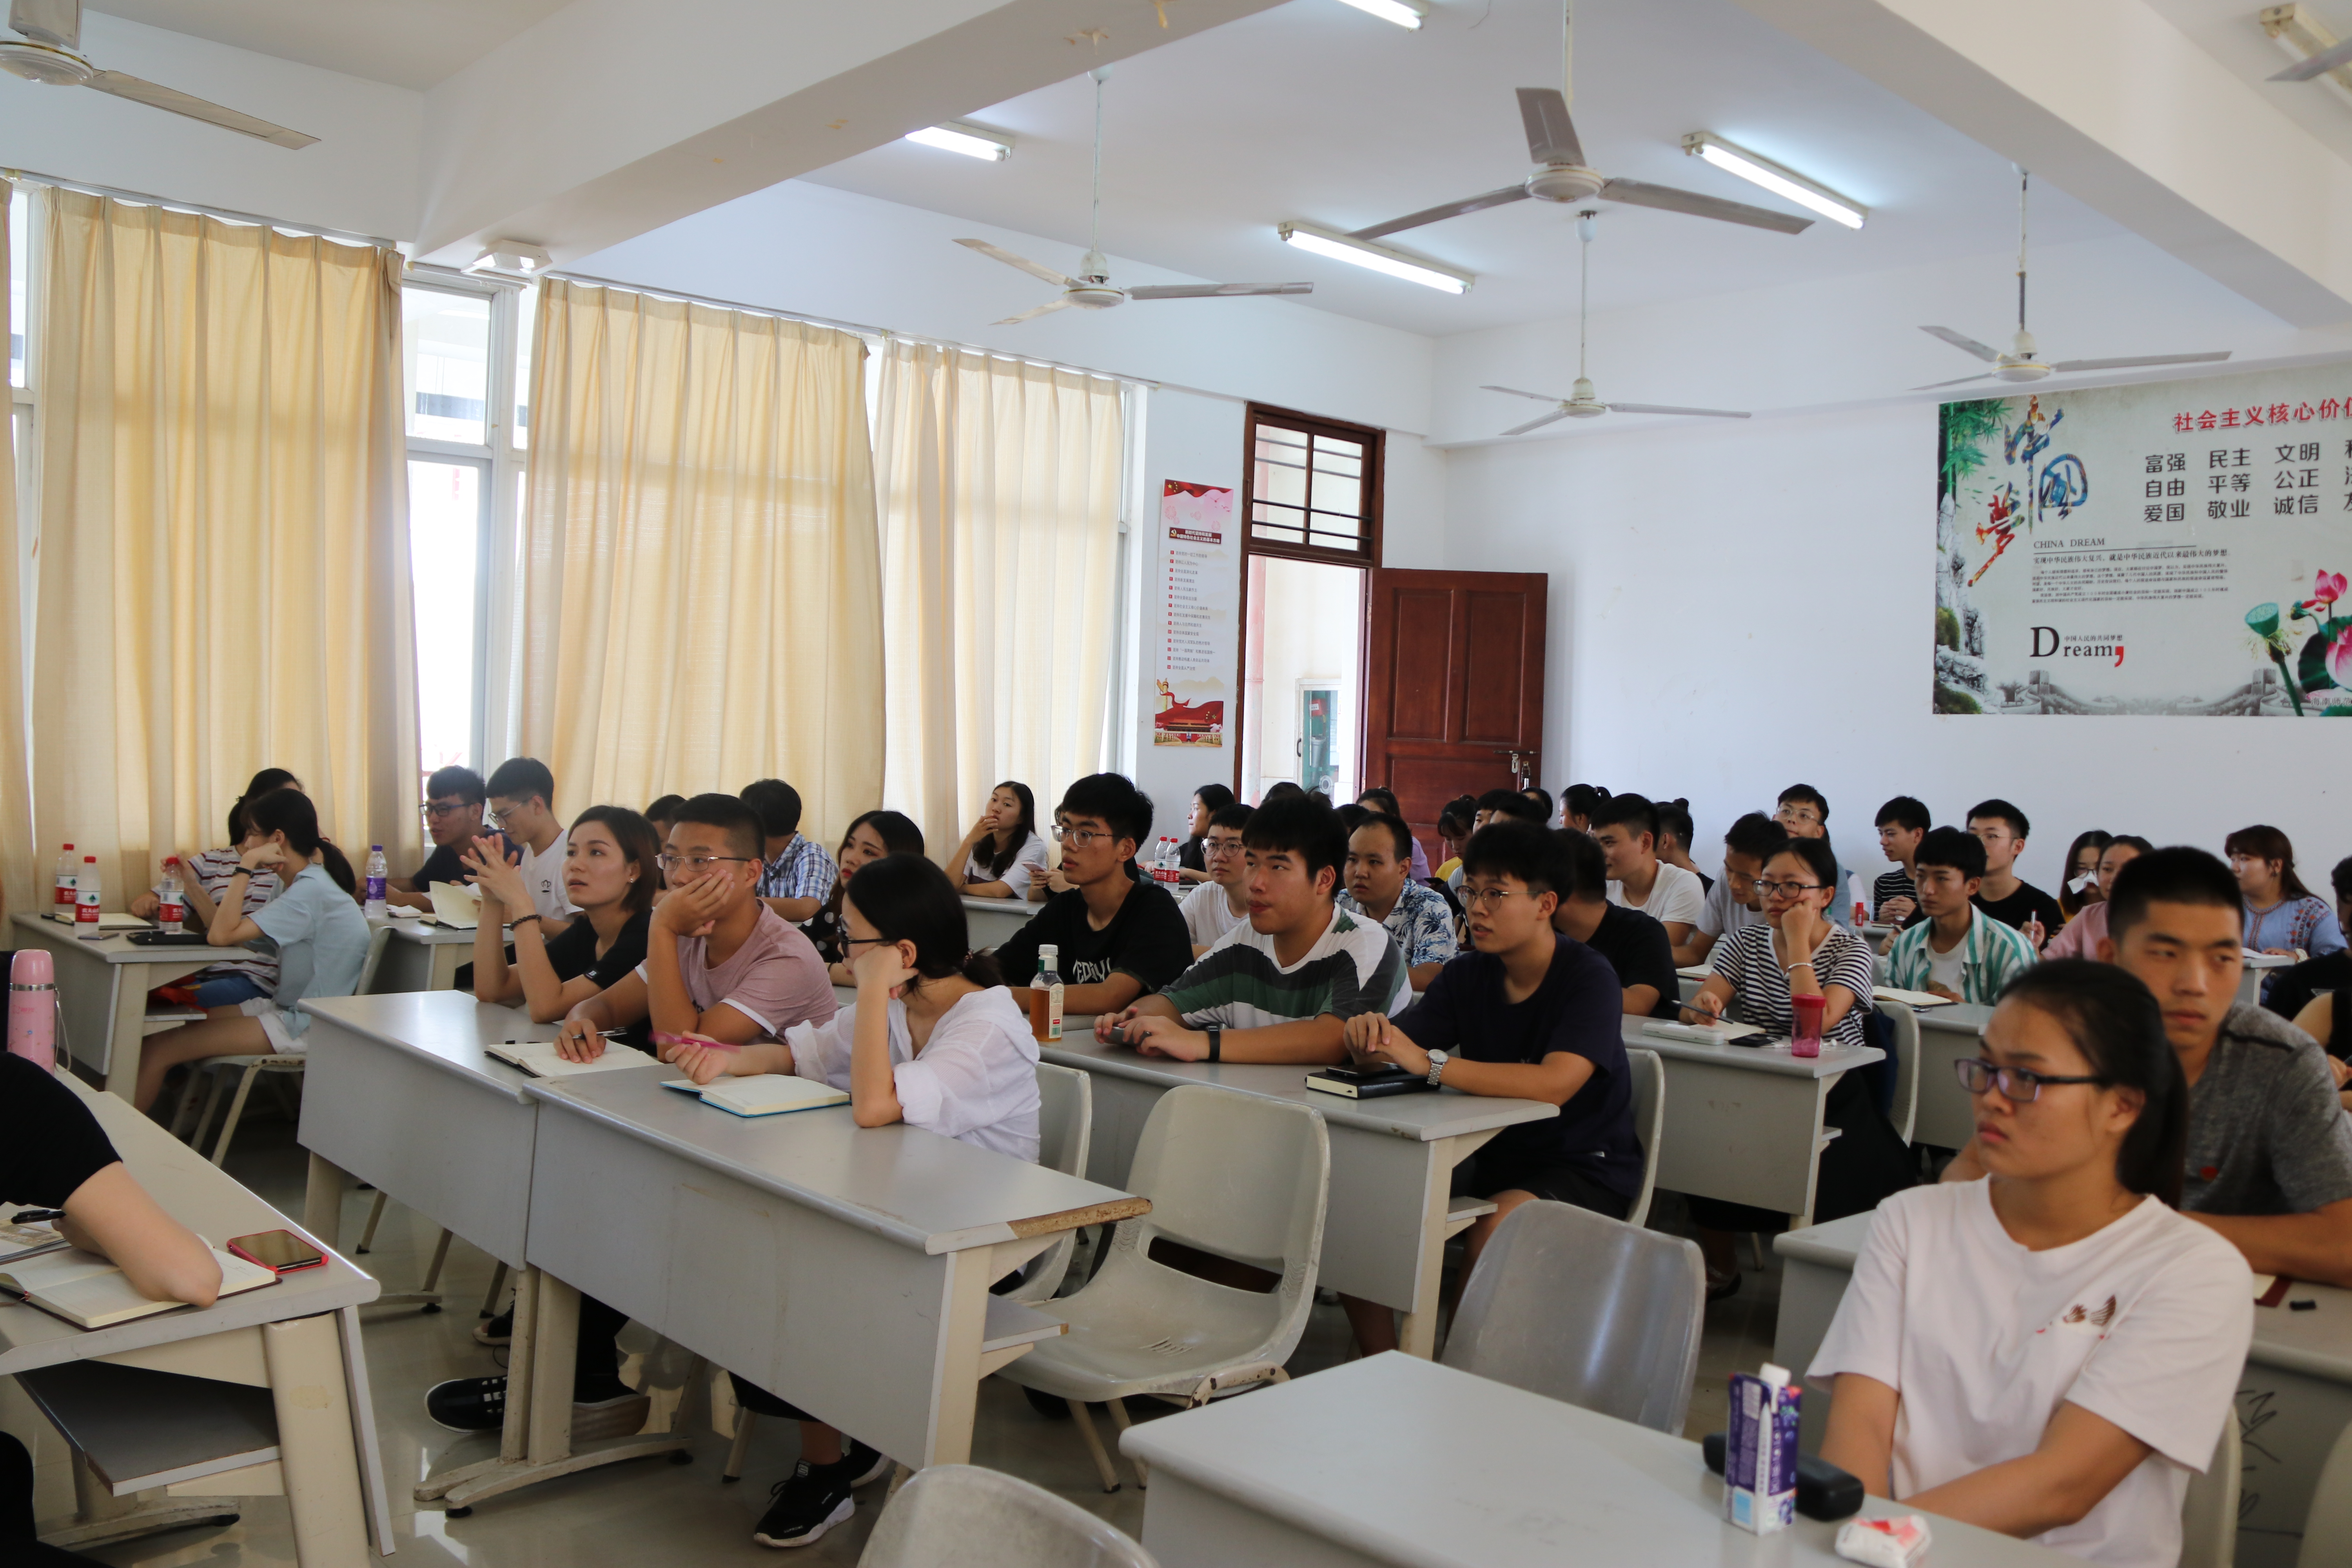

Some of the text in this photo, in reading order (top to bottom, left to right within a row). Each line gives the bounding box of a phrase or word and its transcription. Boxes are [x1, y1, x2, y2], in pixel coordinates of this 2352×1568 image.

[2145, 453, 2185, 473] 富强
[2209, 448, 2250, 469] 民主
[2274, 442, 2319, 464] 文明
[2145, 468, 2319, 498] 自由 平等 公正
[2144, 494, 2319, 523] 爱国 敬业 诚信
[2034, 538, 2105, 548] CHINA DREAM
